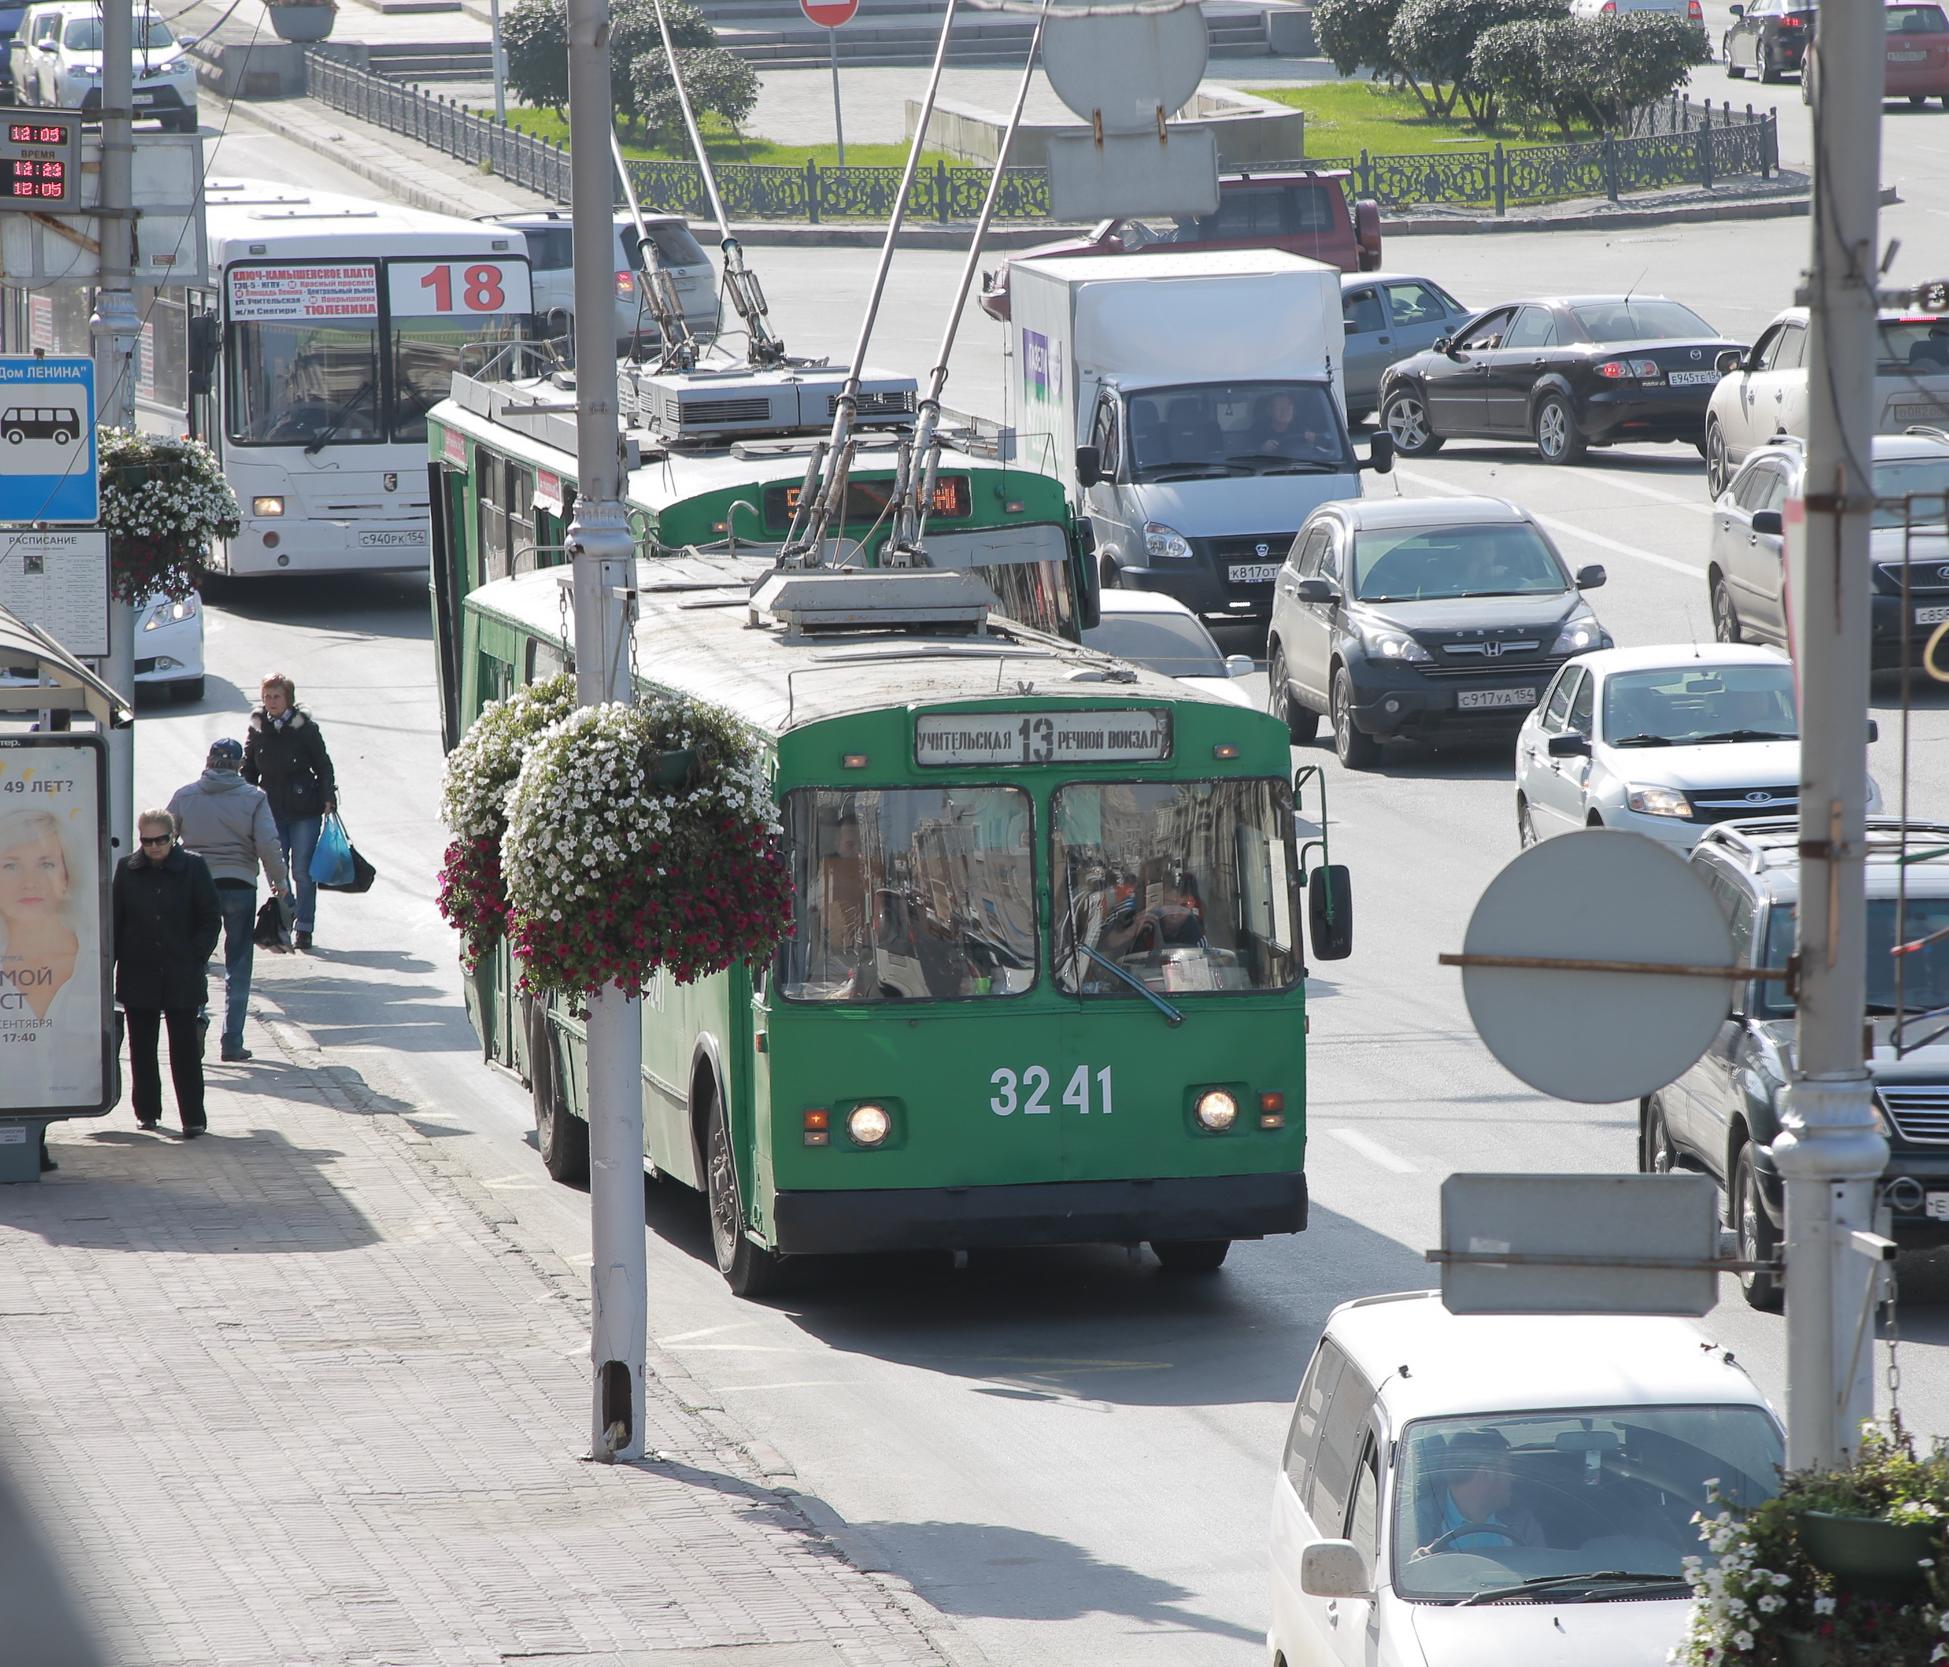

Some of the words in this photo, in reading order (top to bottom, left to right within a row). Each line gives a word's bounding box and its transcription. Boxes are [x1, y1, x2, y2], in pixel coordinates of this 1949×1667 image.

[11, 126, 60, 142] 12:05
[21, 150, 55, 159] ВРЕМЯ
[14, 182, 62, 197] 12:05
[344, 268, 374, 279] ПЛАТО
[421, 265, 505, 312] 18
[304, 304, 377, 316] ТЮЛЕНИНА
[9, 537, 78, 545] РАСПИСАНИЕ
[918, 732, 1012, 750] УЧИТЕЛЬСКАЯ
[1019, 717, 1054, 762] 13
[1057, 730, 1104, 750] РЕЧНОЙ
[1108, 730, 1159, 750] ВОКЗАЛ
[4, 781, 25, 793] 49
[31, 780, 74, 793] ЛЕТ?
[3, 1033, 36, 1042] 17:40
[990, 1064, 1113, 1117] 3241
